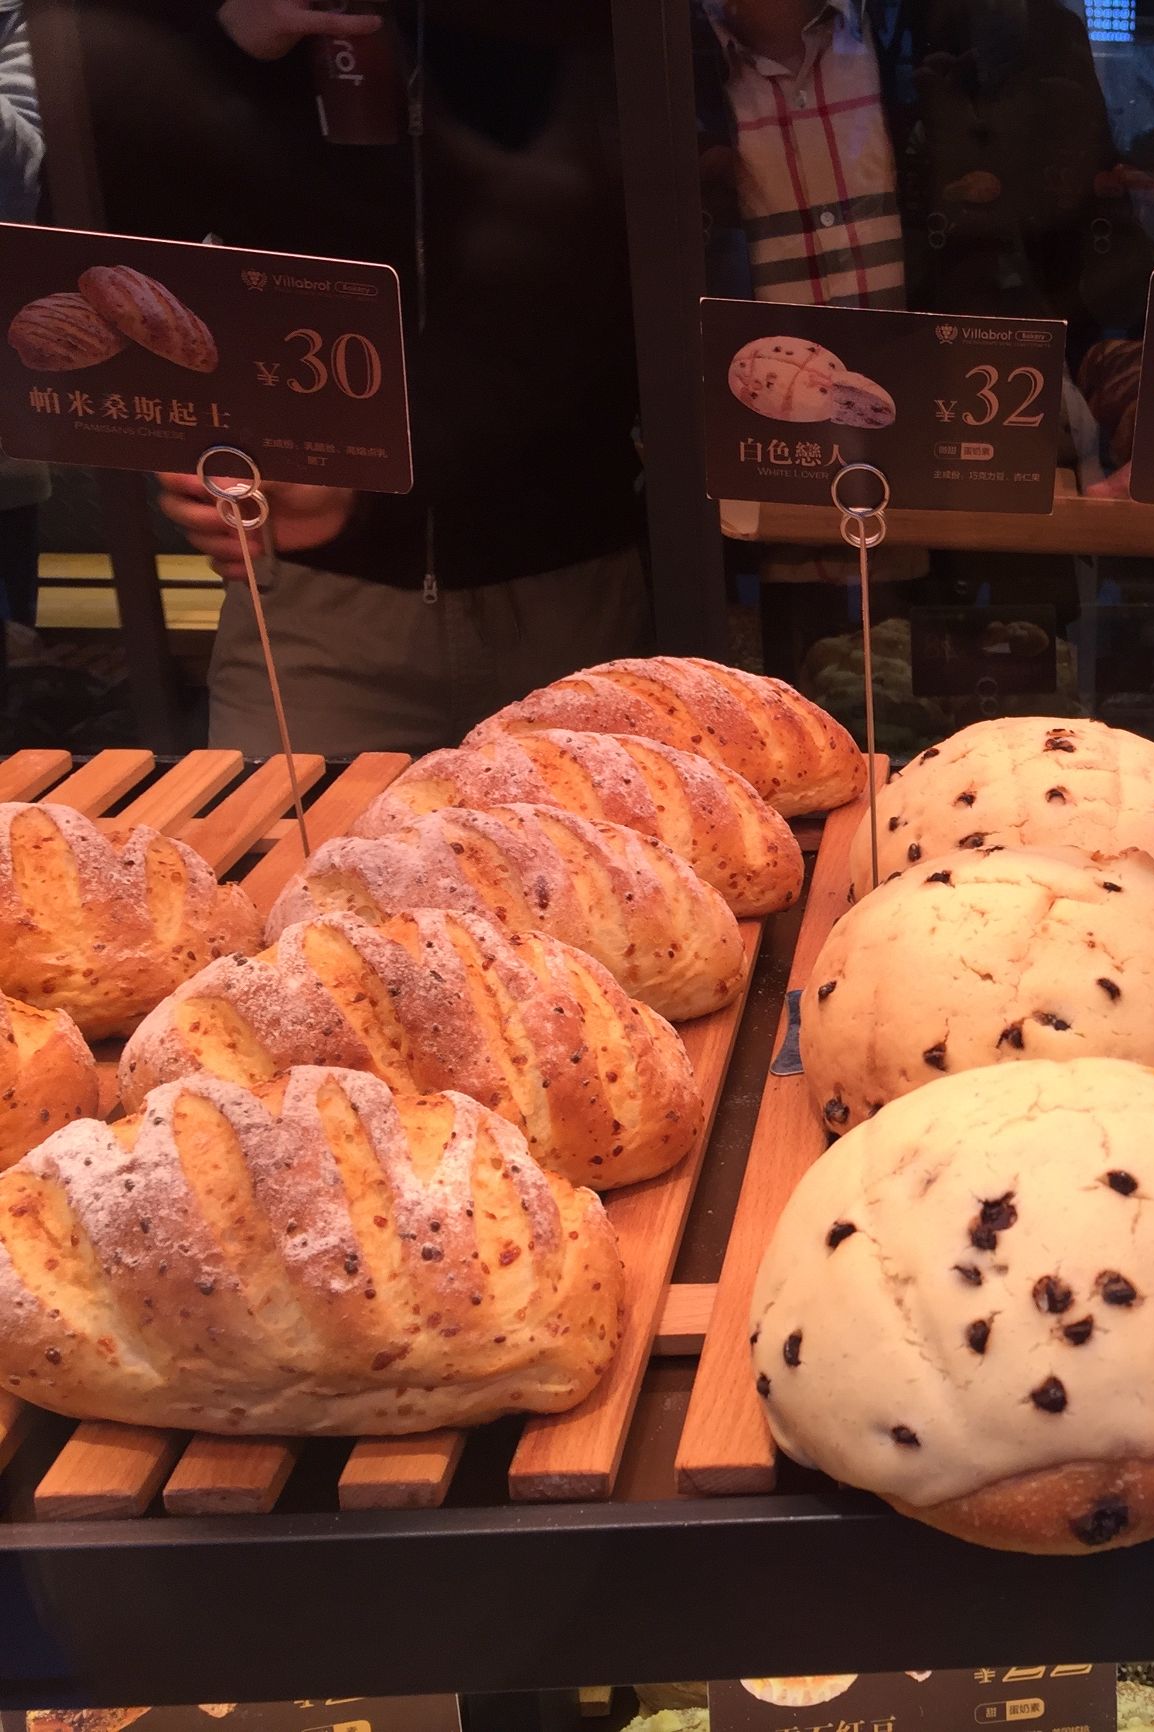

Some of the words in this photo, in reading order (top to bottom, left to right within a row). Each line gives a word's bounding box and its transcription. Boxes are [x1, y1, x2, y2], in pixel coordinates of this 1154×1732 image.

[272, 274, 331, 292] Villabrot
[962, 327, 1012, 341] Villabrot
[739, 437, 849, 467] 白色戀人
